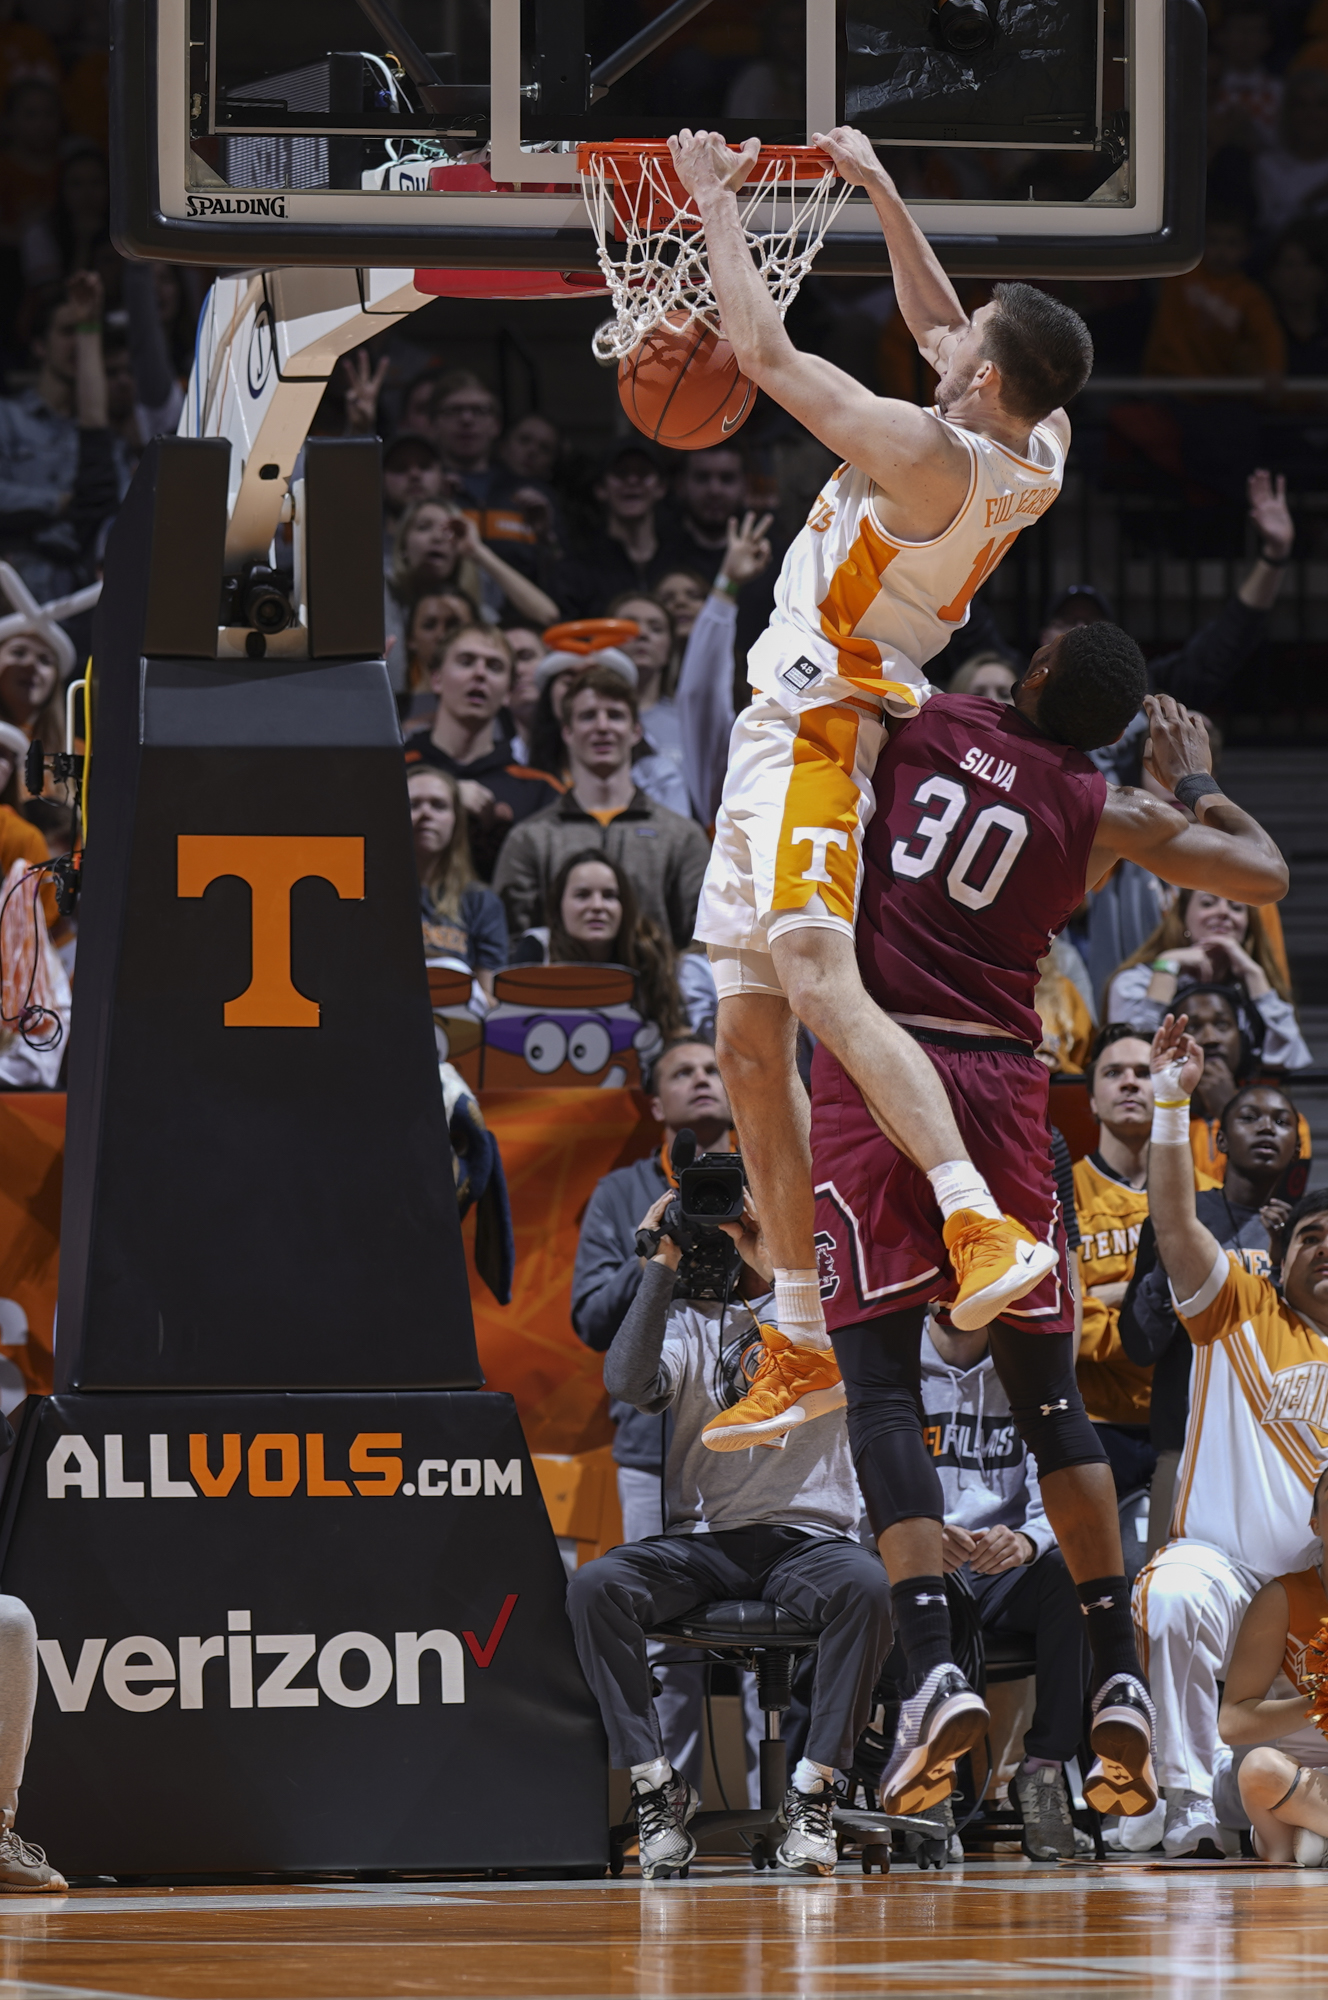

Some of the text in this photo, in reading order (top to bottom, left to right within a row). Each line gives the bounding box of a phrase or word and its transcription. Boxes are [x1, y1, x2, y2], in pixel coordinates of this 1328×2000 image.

[186, 195, 286, 218] SPALDING
[799, 662, 814, 675] 48
[959, 747, 1018, 792] SILVA
[791, 827, 849, 883] T
[889, 770, 1034, 916] 30
[177, 835, 365, 1027] T
[46, 1432, 523, 1499] ALLVOLS.COM
[36, 1609, 466, 1713] verizon
